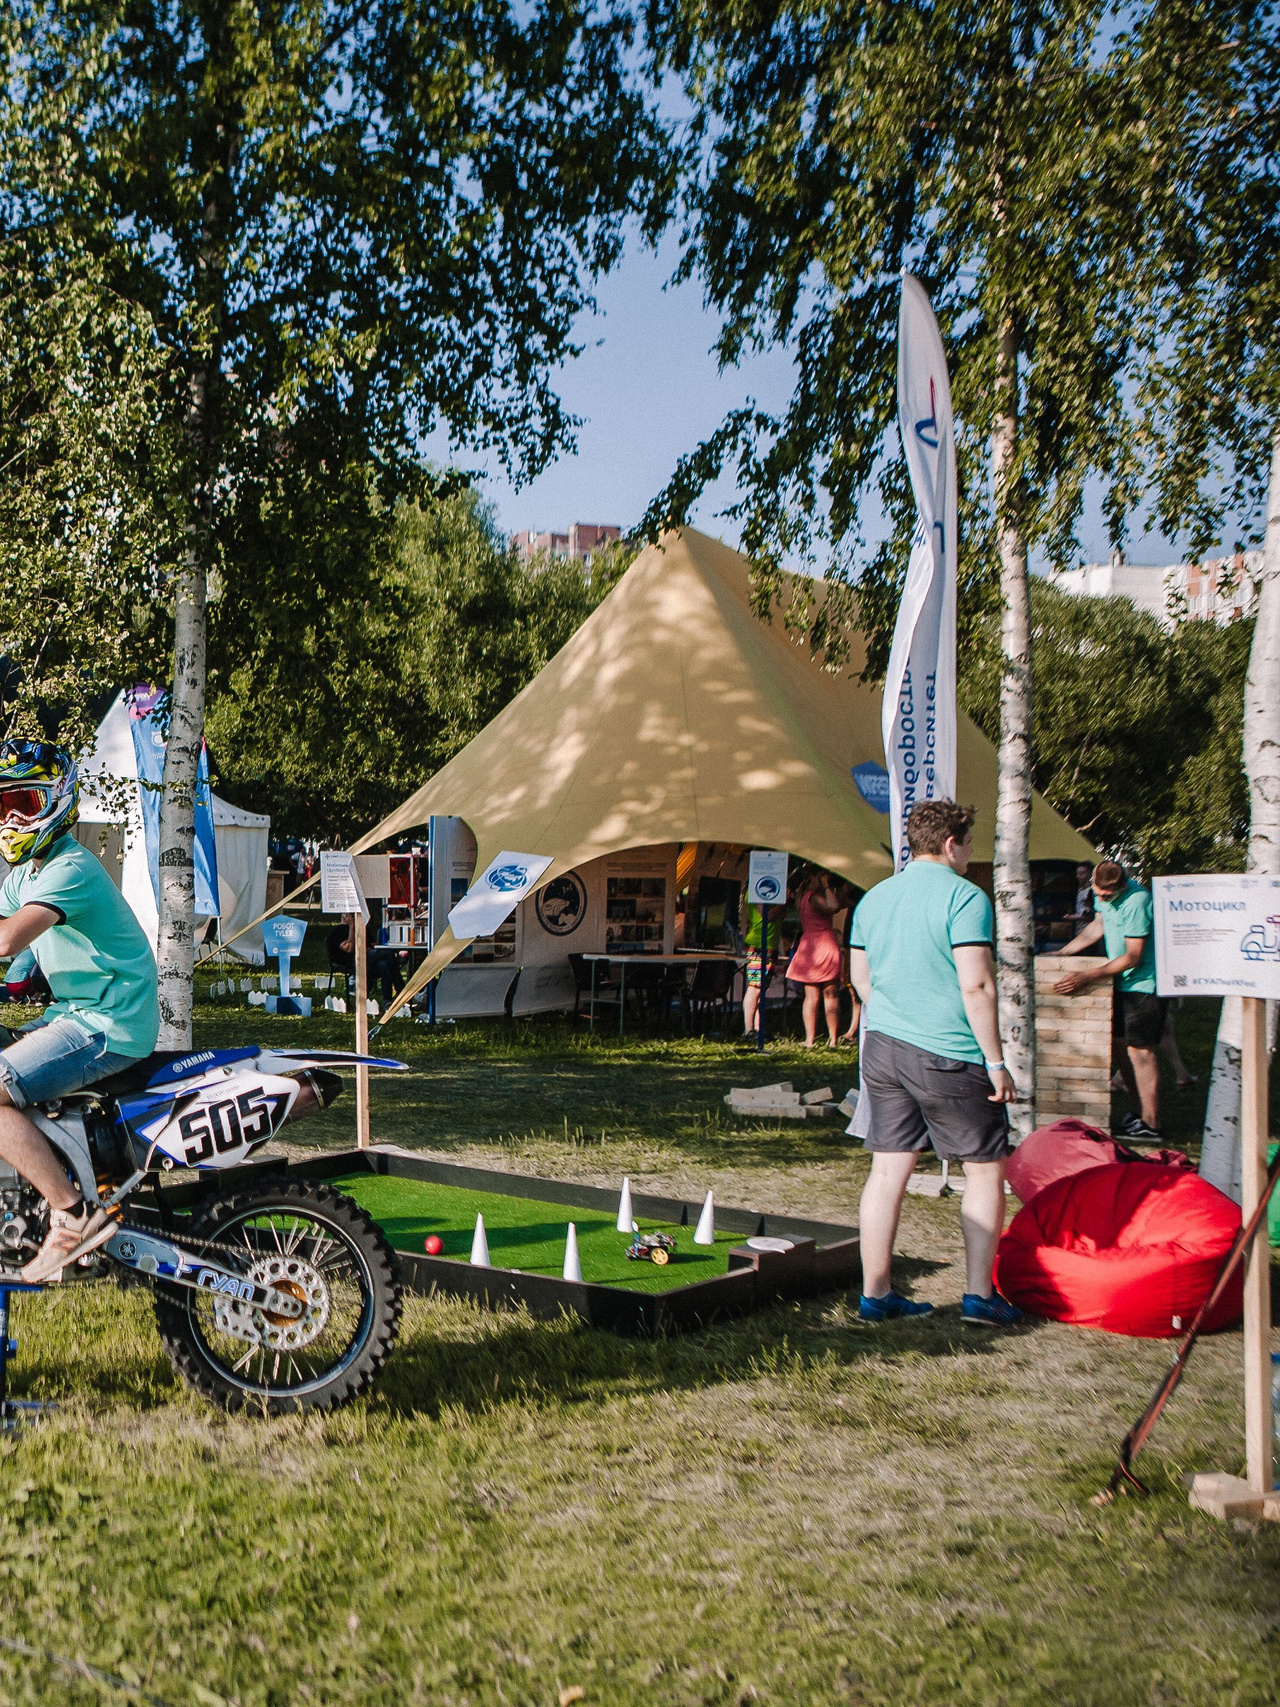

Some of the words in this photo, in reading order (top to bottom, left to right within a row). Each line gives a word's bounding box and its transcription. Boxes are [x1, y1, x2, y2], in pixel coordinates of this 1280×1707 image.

[1169, 899, 1246, 912] Мотоцикл
[273, 922, 295, 930] РОБОТ
[181, 1051, 216, 1069] YAMAHA
[178, 1086, 271, 1166] 505
[197, 1268, 255, 1301] ГУАП
